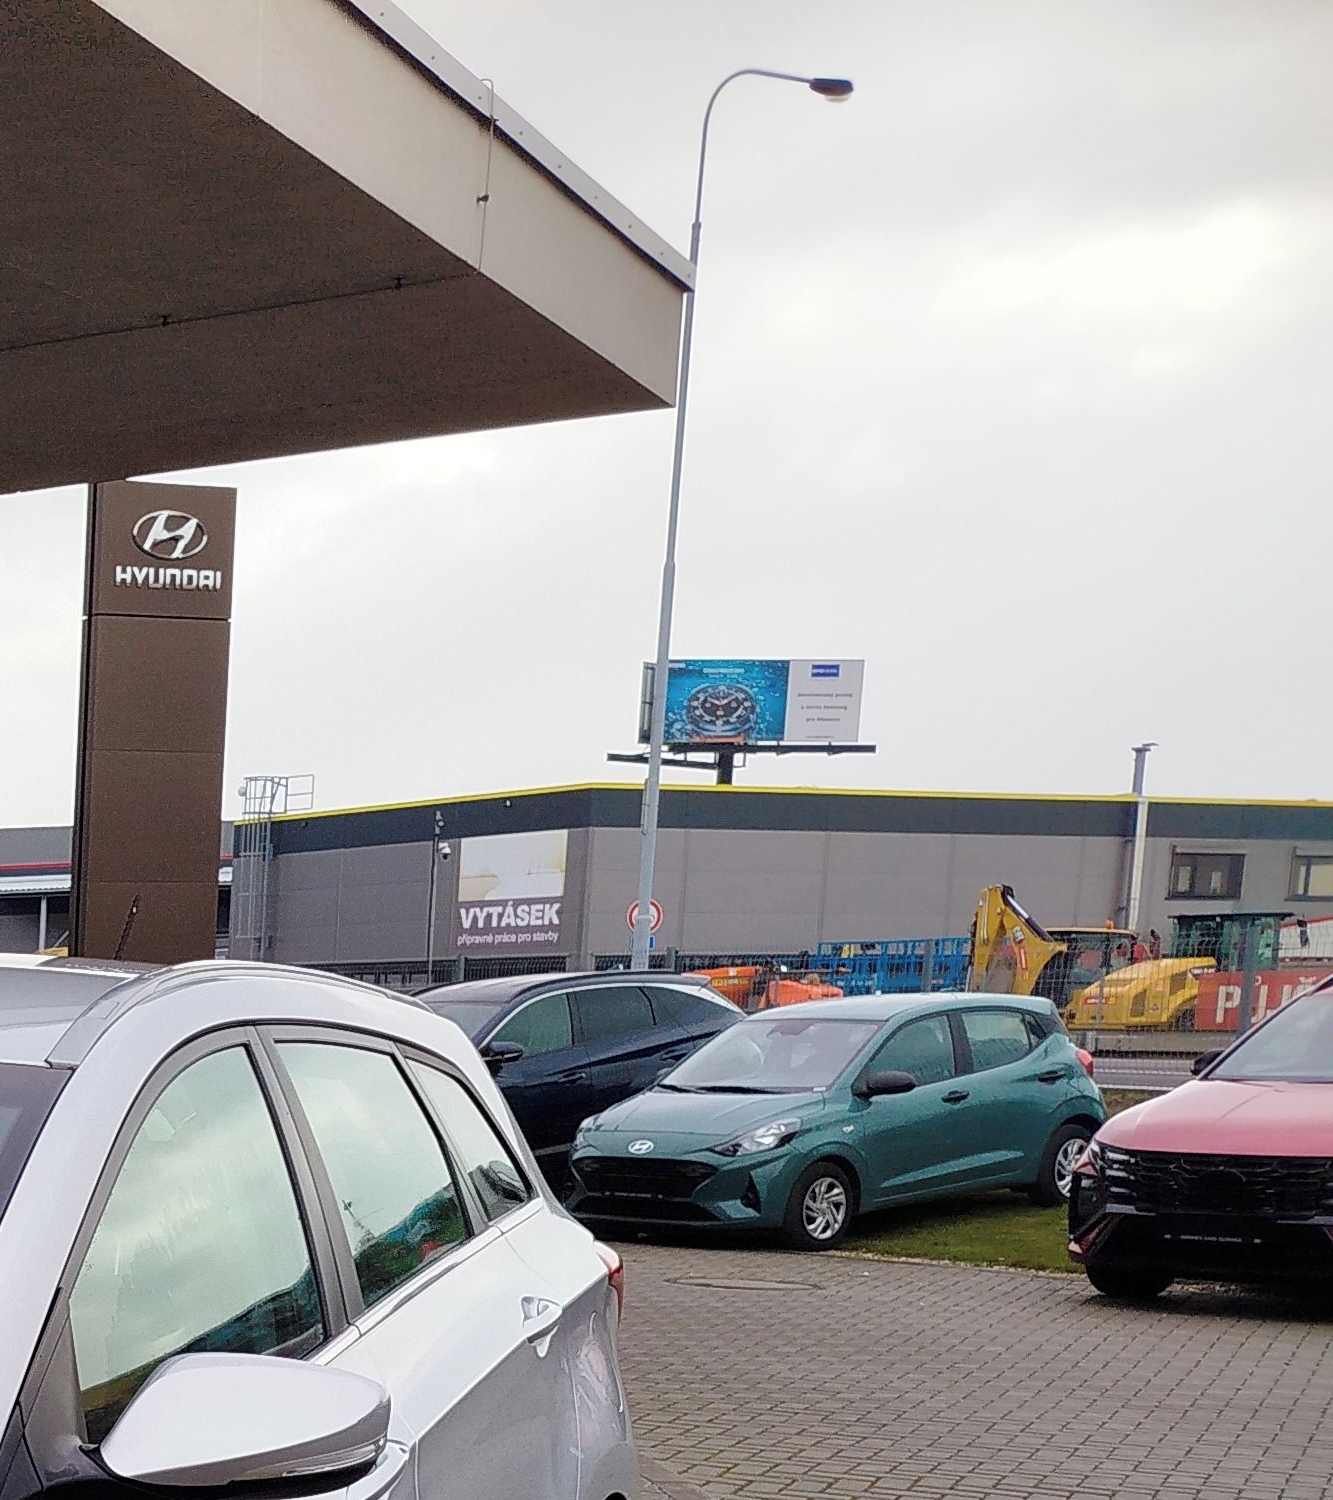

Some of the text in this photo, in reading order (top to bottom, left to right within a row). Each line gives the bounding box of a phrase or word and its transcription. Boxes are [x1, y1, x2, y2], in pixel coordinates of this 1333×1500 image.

[115, 565, 222, 590] HYUNDAI
[459, 901, 562, 929] VYTÁSEK
[494, 932, 517, 945] práce
[518, 933, 532, 944] pro
[533, 930, 559, 943] stavby
